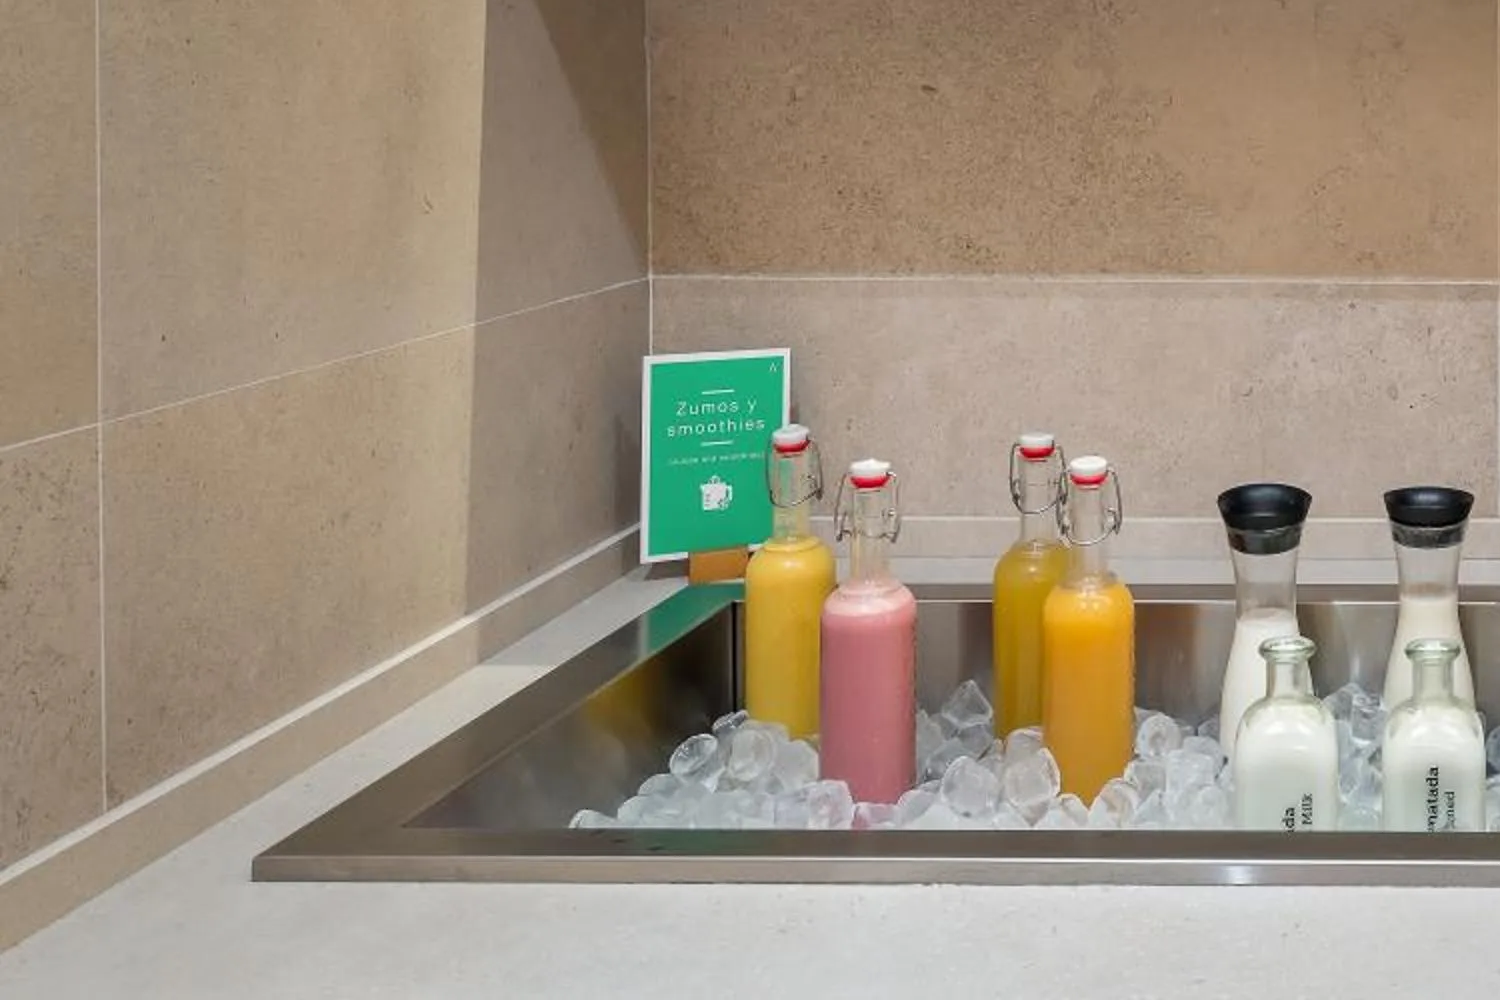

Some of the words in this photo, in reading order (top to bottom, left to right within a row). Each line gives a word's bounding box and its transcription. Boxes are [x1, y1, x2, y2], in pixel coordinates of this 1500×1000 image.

[675, 400, 738, 417] Zumos
[747, 398, 757, 414] y
[666, 418, 766, 438] smoothies
[1282, 806, 1295, 832] da
